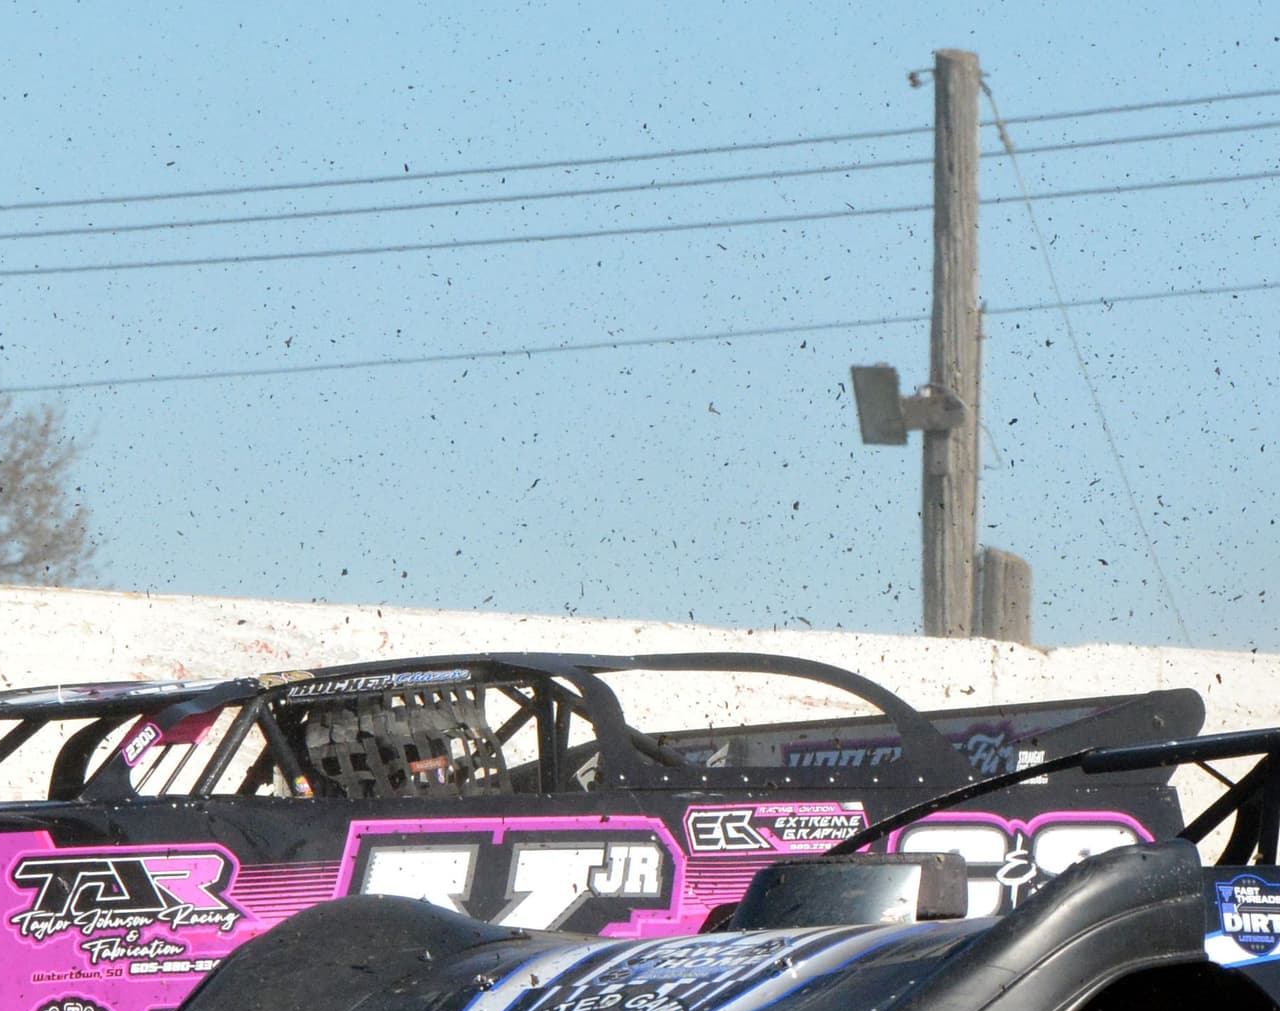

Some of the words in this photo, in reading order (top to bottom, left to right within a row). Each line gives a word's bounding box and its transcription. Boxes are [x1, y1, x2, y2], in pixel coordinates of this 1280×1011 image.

[125, 725, 158, 763] 2300
[774, 815, 862, 828] EXTREME
[782, 827, 859, 841] GRAPHIX
[591, 844, 663, 895] JR
[1233, 886, 1261, 896] FAST
[11, 909, 72, 940] Taylor
[73, 908, 154, 935] Johnson
[157, 903, 241, 932] Racing
[126, 929, 140, 943] &
[81, 937, 185, 964] Fabrication
[32, 969, 103, 983] Watertown,
